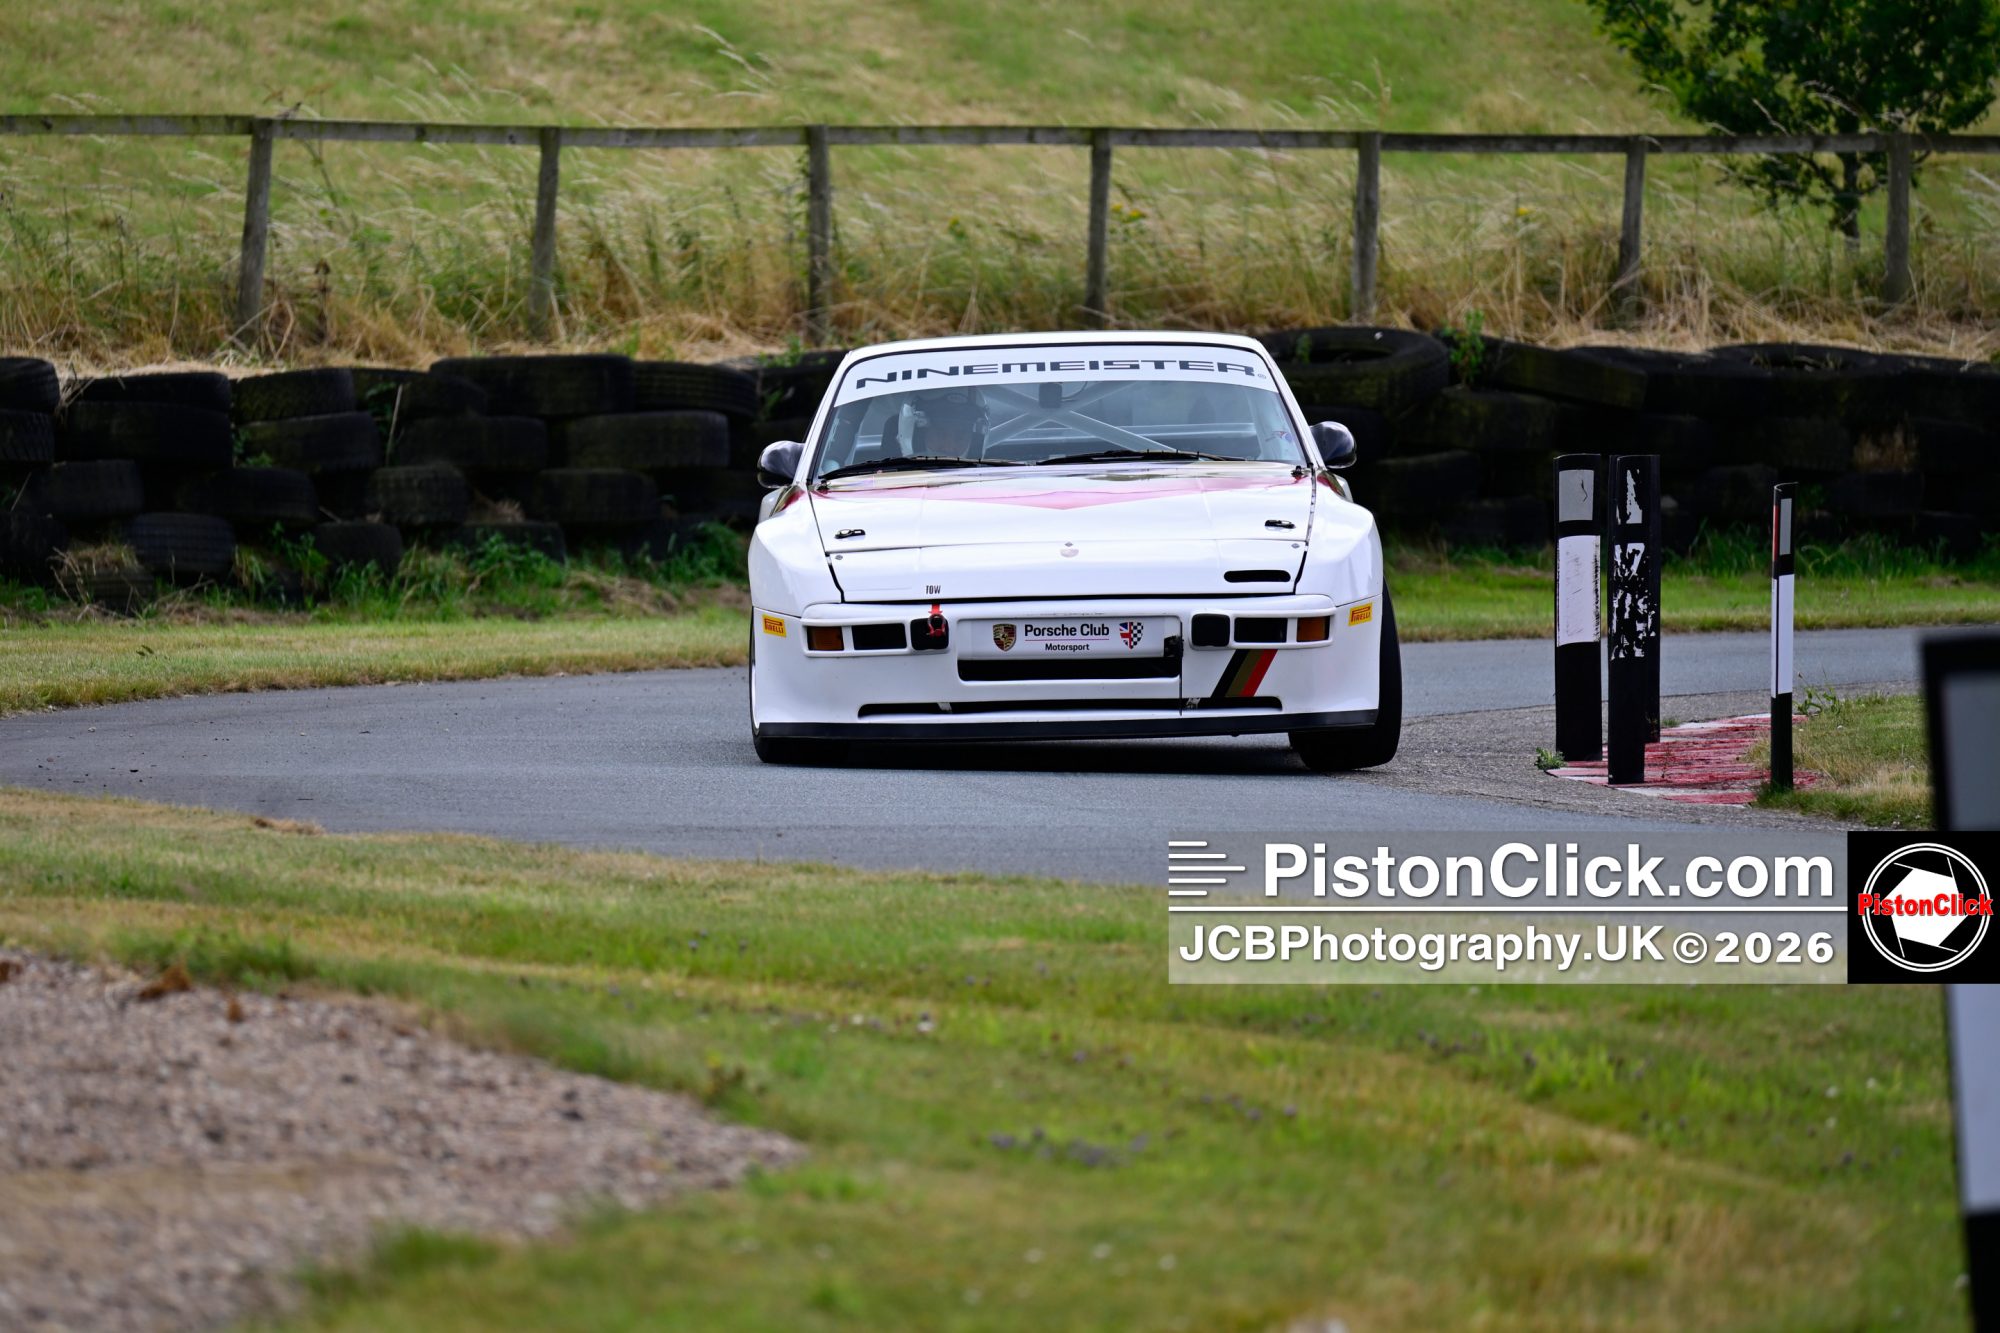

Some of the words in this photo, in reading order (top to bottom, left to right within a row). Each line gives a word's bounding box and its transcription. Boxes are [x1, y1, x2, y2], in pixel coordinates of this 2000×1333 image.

[925, 585, 941, 594] TOW
[1024, 624, 1077, 637] Porsche
[1080, 623, 1110, 636] Club
[1045, 643, 1090, 652] Motorsport
